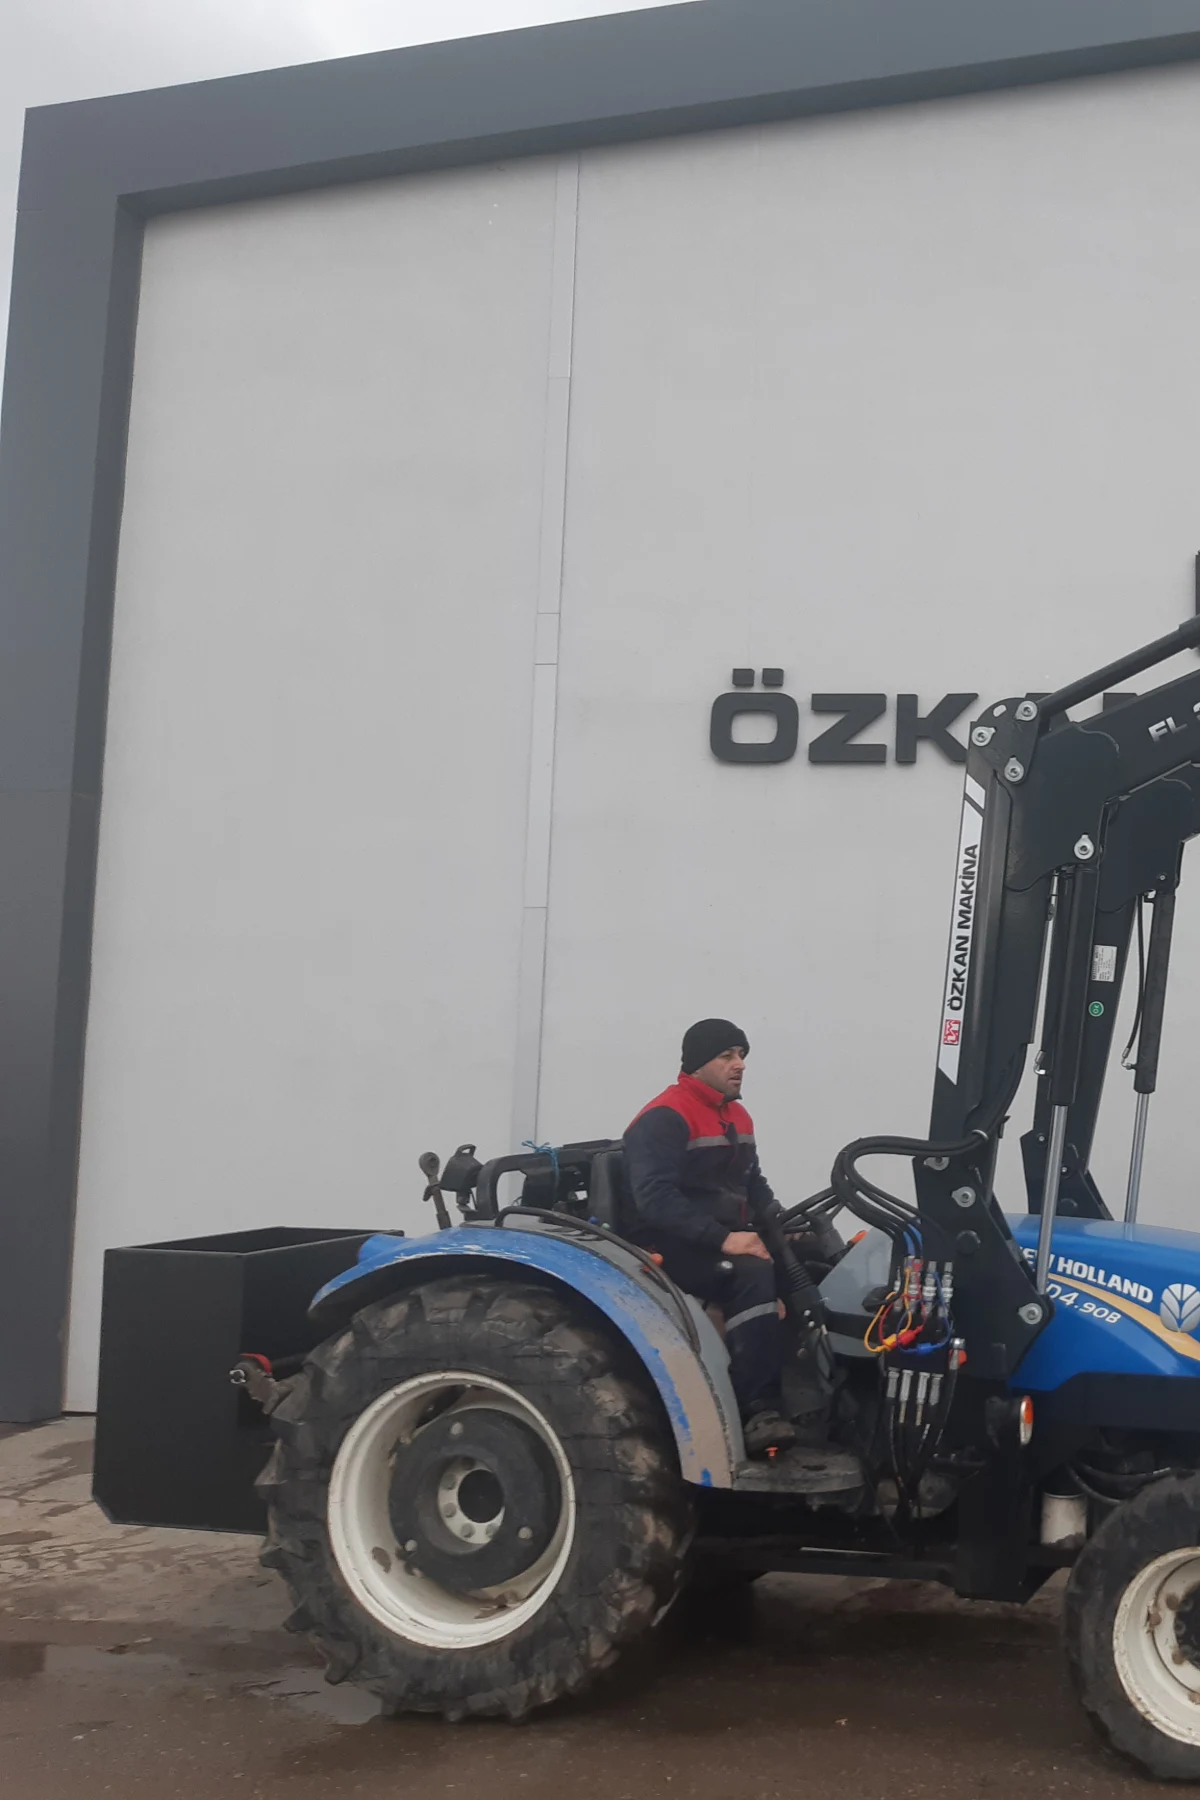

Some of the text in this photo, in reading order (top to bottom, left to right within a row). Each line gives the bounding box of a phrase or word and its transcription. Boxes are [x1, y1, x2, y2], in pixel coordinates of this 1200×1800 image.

[1148, 716, 1187, 742] FL
[956, 843, 979, 930] MAKİNA
[946, 934, 970, 1012] ÖZKAN
[1046, 1281, 1122, 1324] D4.90B
[1057, 1257, 1153, 1303] HOLLAND
